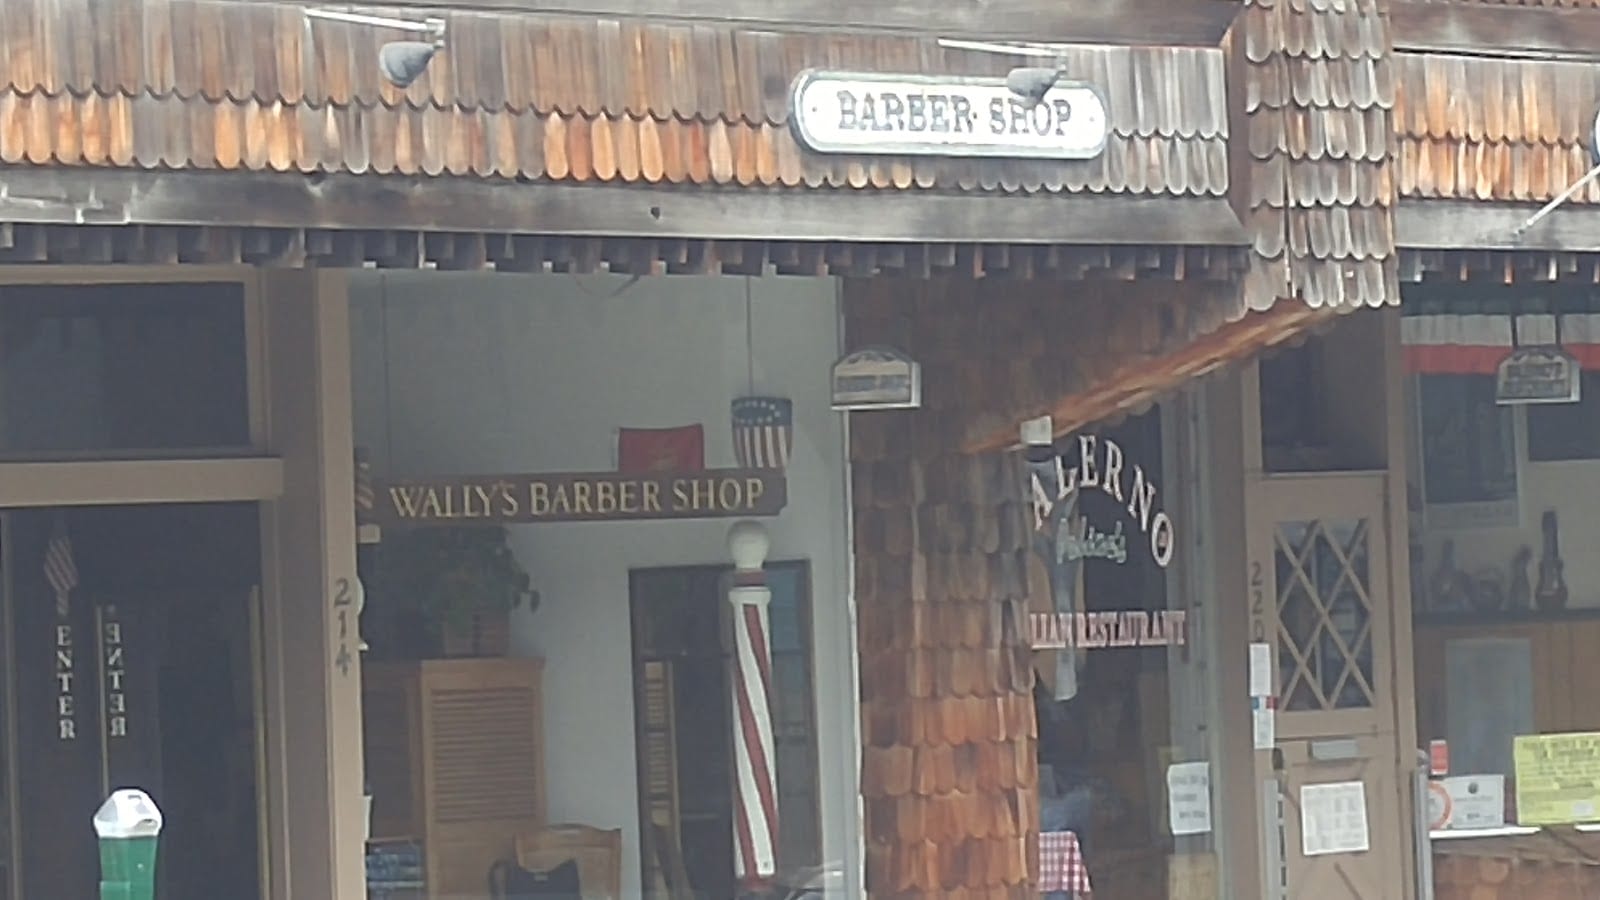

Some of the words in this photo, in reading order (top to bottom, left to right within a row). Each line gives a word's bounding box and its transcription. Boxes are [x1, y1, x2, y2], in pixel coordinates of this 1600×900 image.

[837, 90, 973, 133] BARBER
[989, 97, 1072, 136] SHOP
[530, 480, 662, 515] BARBER
[672, 476, 765, 511] SHOP
[334, 578, 352, 677] 214
[1076, 610, 1185, 648] RESTAURANT
[57, 625, 75, 739] ENTER
